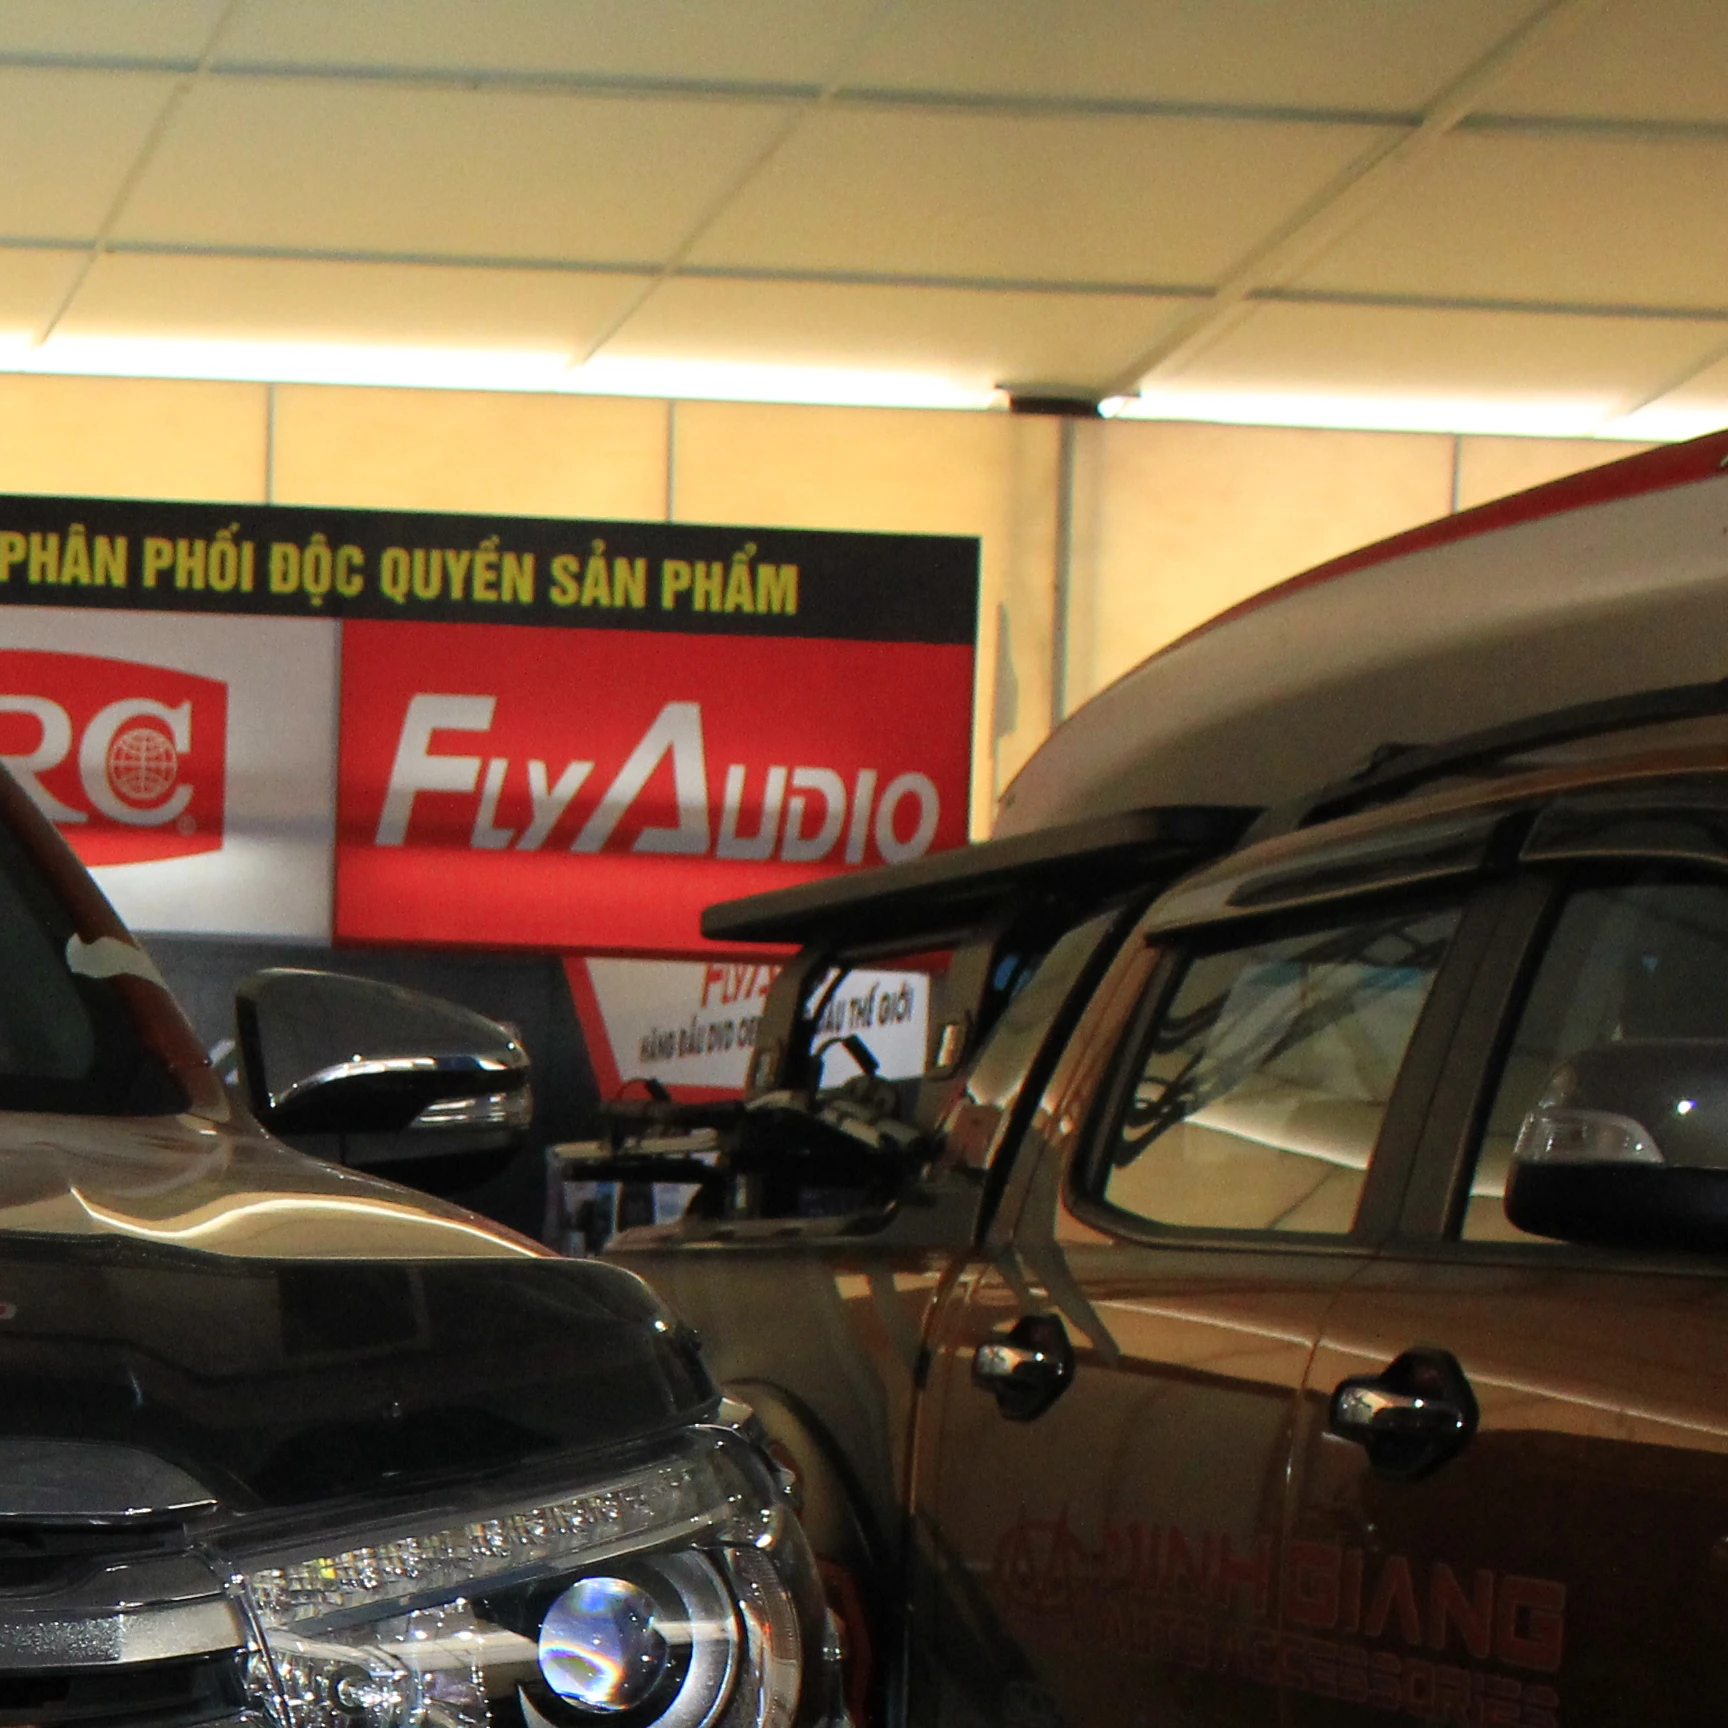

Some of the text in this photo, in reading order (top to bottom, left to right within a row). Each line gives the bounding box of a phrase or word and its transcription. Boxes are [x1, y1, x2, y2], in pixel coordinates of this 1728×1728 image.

[143, 522, 256, 592] PHỐI
[268, 532, 364, 606] ĐỘC
[549, 538, 648, 607] SẢN
[660, 541, 800, 615] PHẨM
[1285, 1537, 1567, 1672] GIANG
